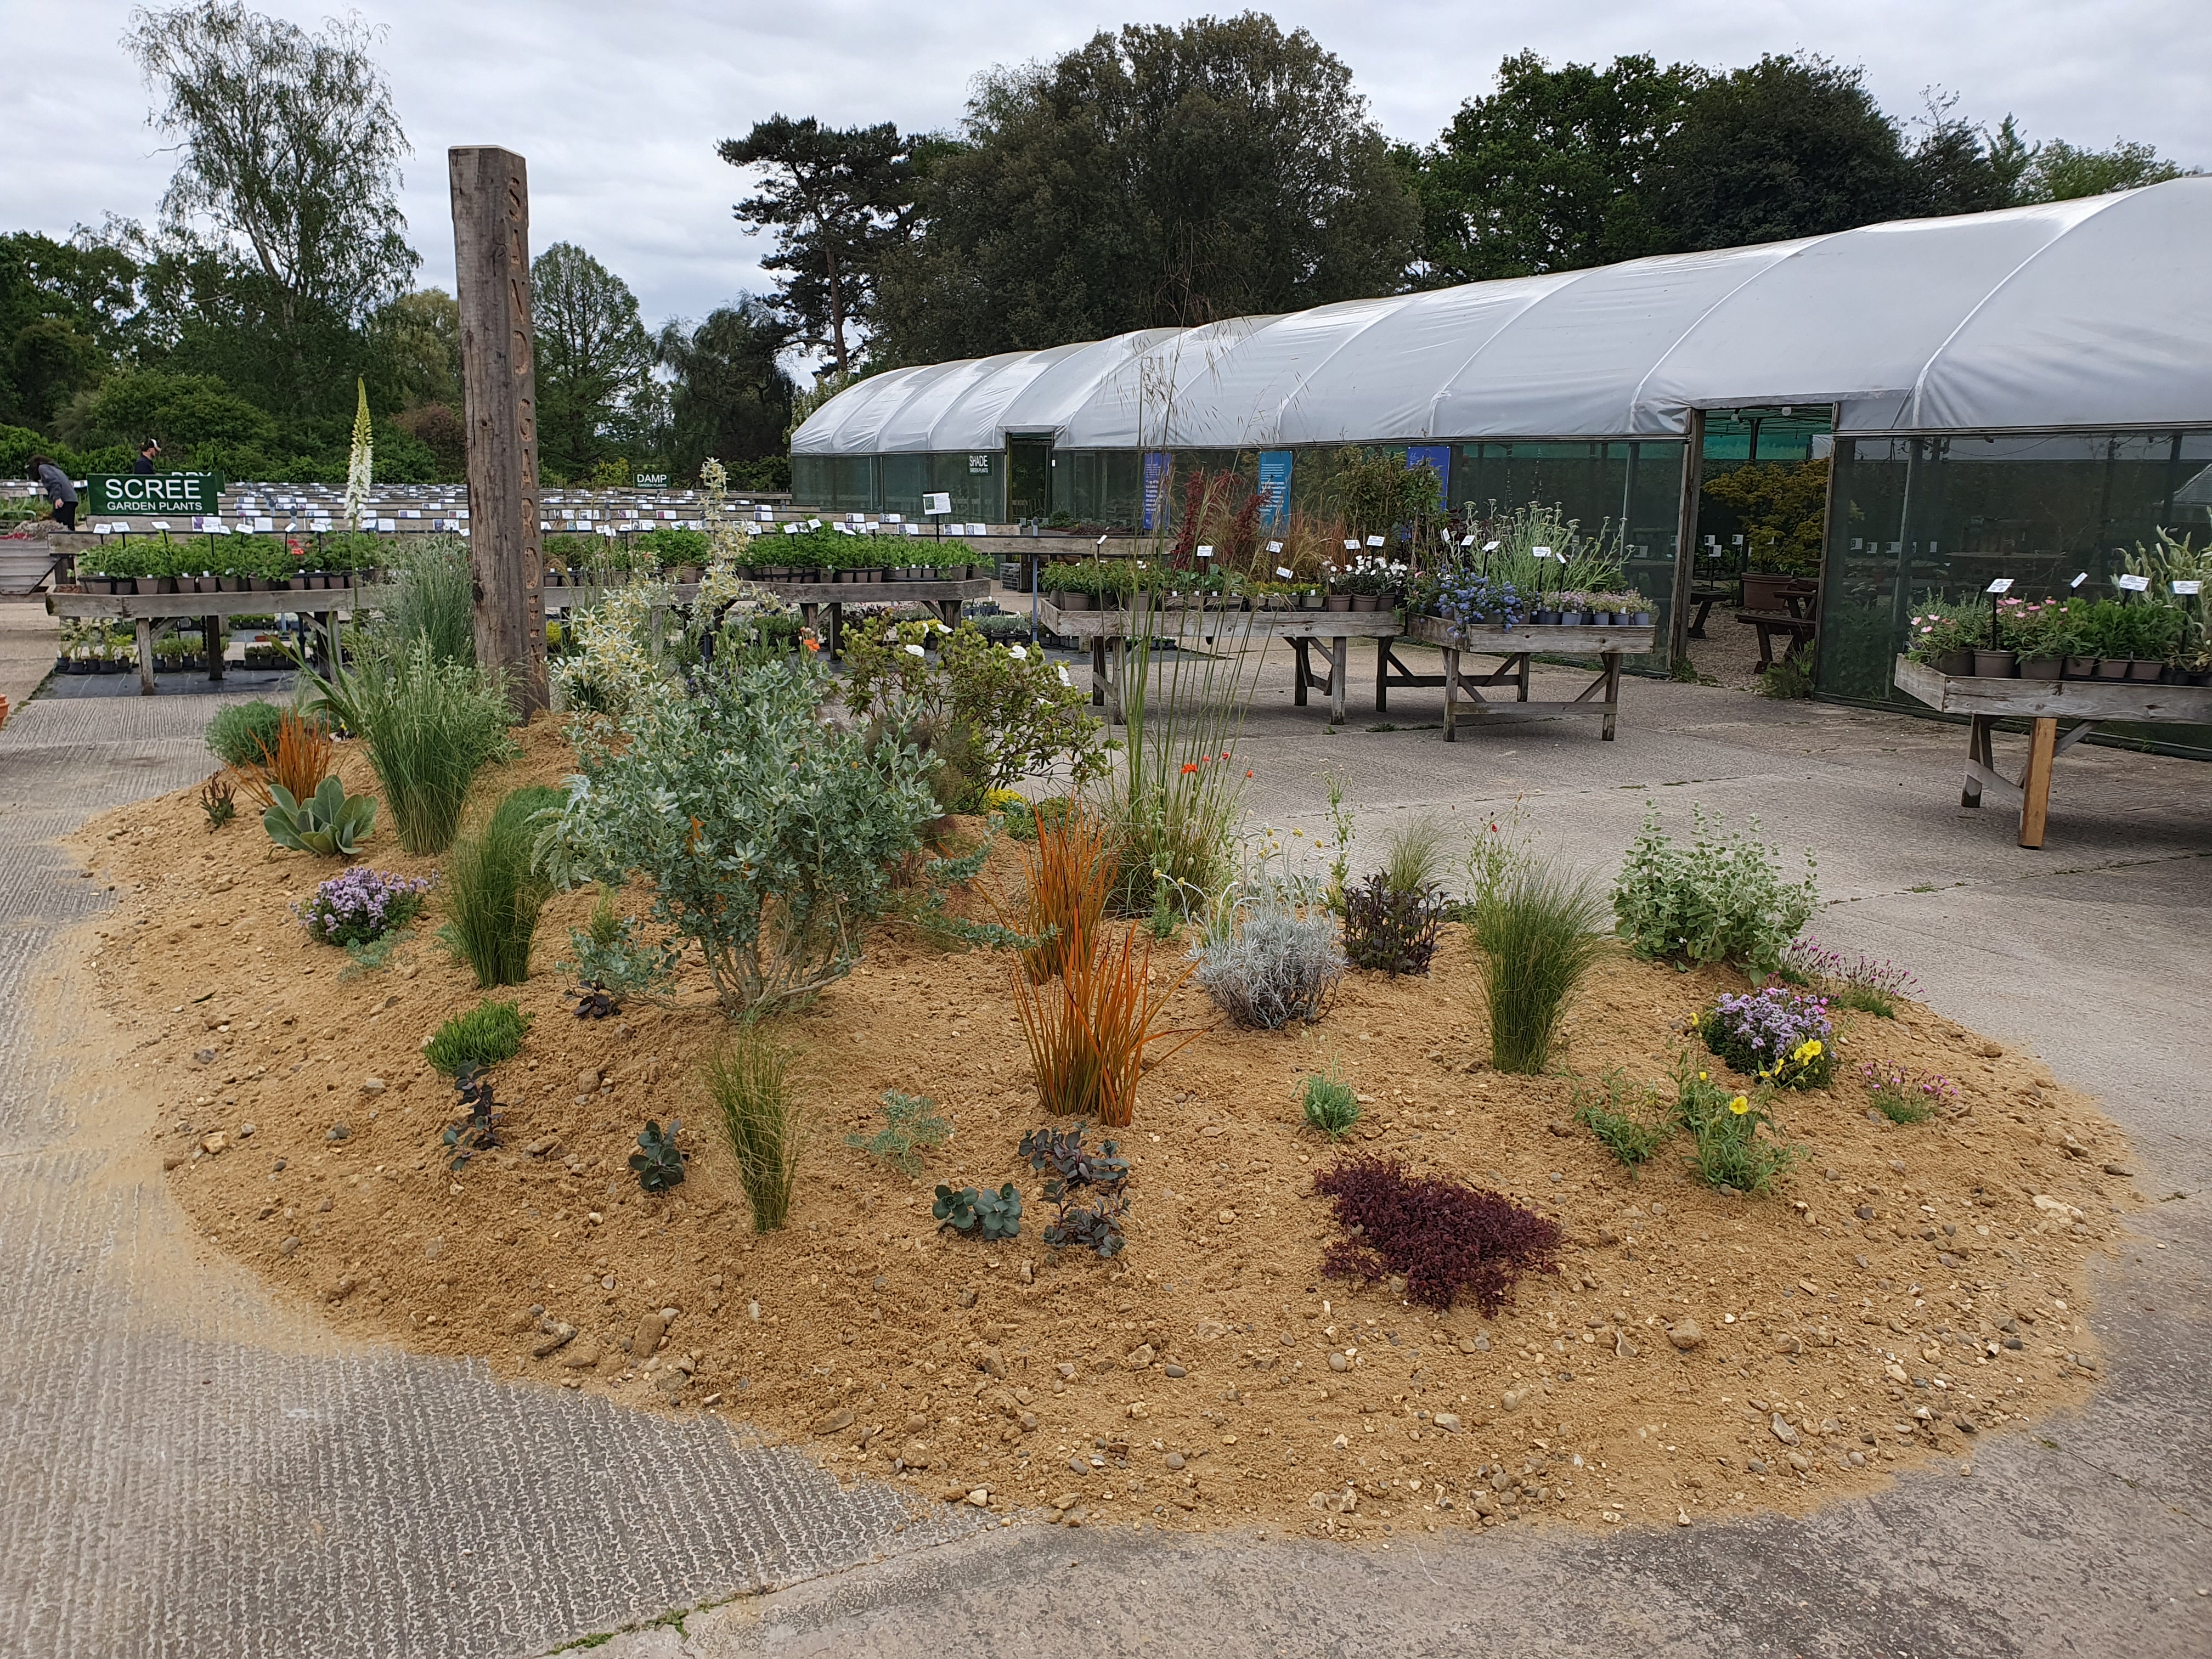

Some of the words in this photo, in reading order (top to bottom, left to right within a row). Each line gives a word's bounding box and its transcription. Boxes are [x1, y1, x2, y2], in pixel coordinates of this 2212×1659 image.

[969, 455, 988, 467] SHADE
[637, 474, 667, 483] DAMP
[105, 479, 201, 499] SCREE
[107, 501, 156, 511] GARDEN
[159, 501, 202, 511] PLANTS
